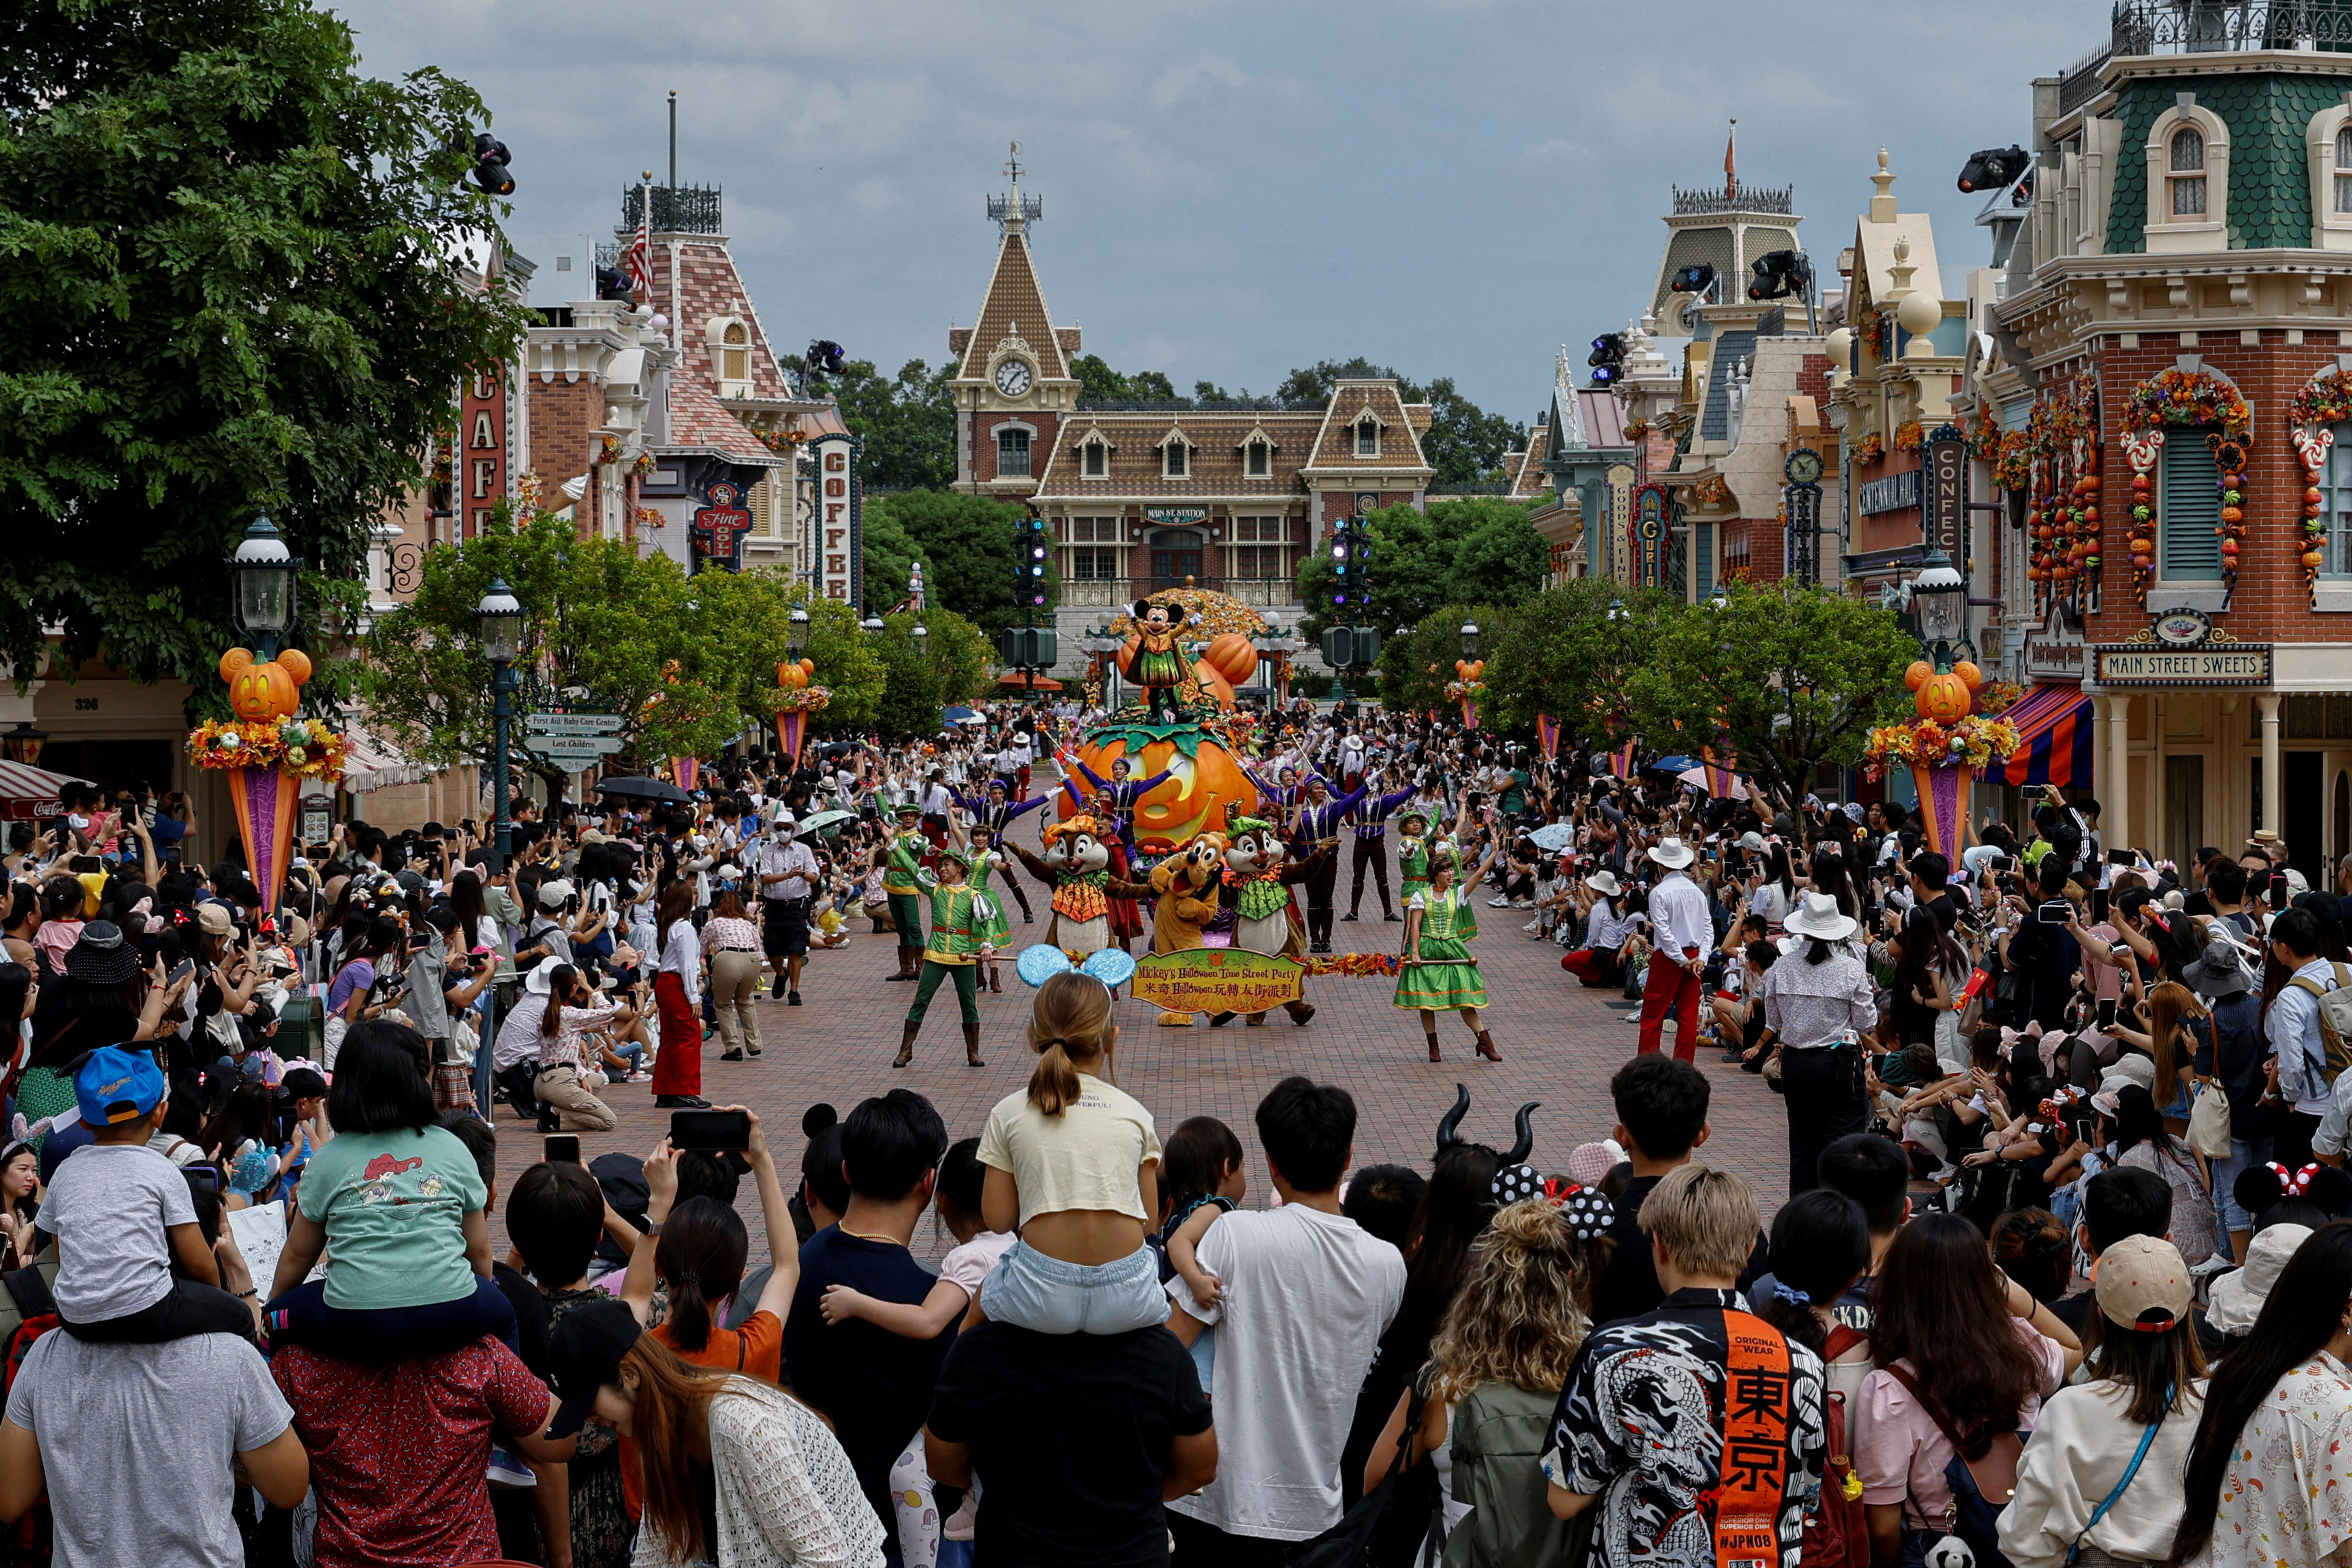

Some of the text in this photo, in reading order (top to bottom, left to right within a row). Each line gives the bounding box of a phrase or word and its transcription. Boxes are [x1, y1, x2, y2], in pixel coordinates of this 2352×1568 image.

[1858, 470, 1916, 517] CENTENNIAL HALL
[1148, 510, 1165, 518] MAIN
[1176, 509, 1205, 518] STATION
[1617, 487, 1626, 529] GOODS
[703, 513, 744, 527] Fine
[826, 452, 846, 598] COFFEE
[1618, 548, 1626, 581] FINE
[2109, 657, 2256, 673] MAIN STREET SWEETS
[75, 698, 98, 710] 326
[568, 740, 595, 748] Children
[1138, 966, 1296, 982] Mickey's Halloween Time Street Party
[1735, 1336, 1780, 1348] ORIGINAL
[1744, 1346, 1773, 1356] WEAR
[1725, 1365, 1788, 1492] 東京
[1720, 1534, 1771, 1548] #JPN08
